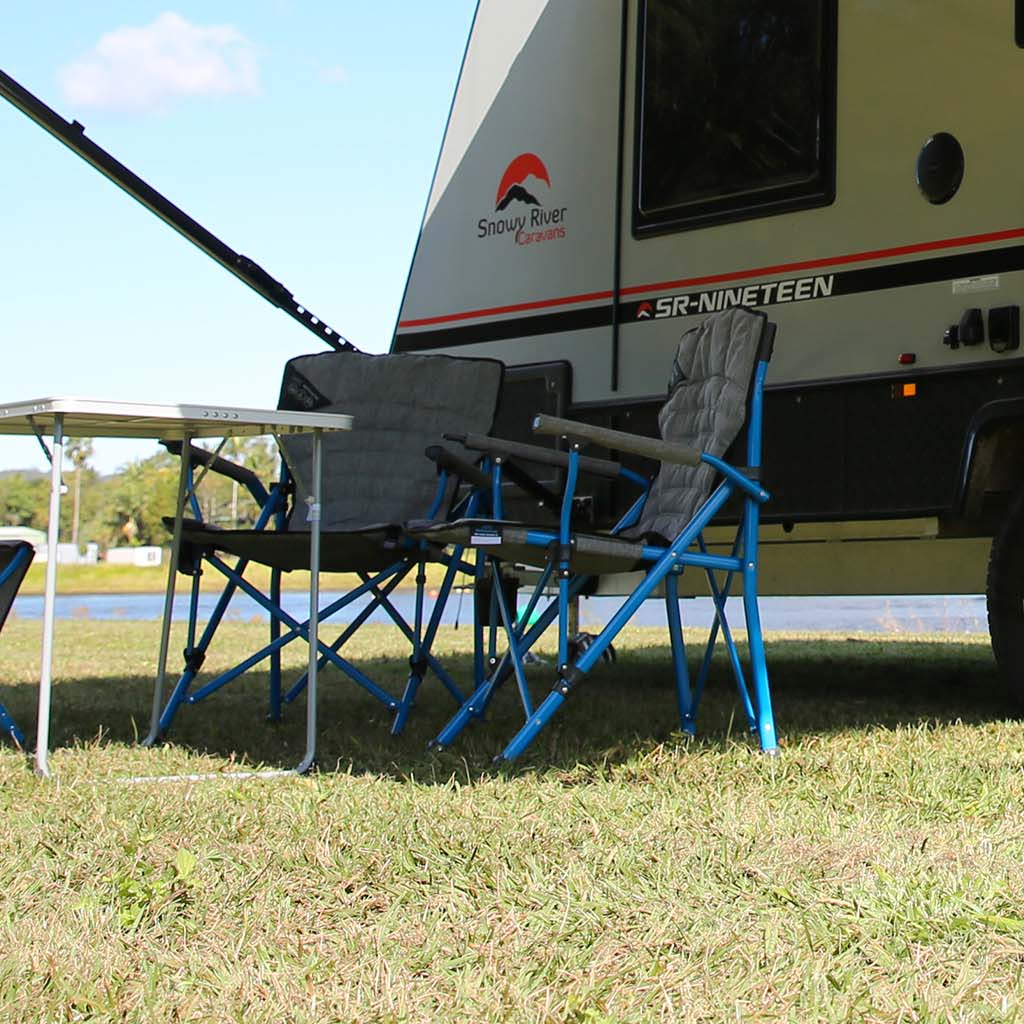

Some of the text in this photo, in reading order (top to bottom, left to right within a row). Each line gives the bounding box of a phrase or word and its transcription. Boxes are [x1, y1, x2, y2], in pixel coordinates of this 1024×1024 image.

[478, 208, 567, 243] Snowy River
[517, 227, 566, 246] Caravans
[655, 275, 834, 318] SR-NINETEEN
